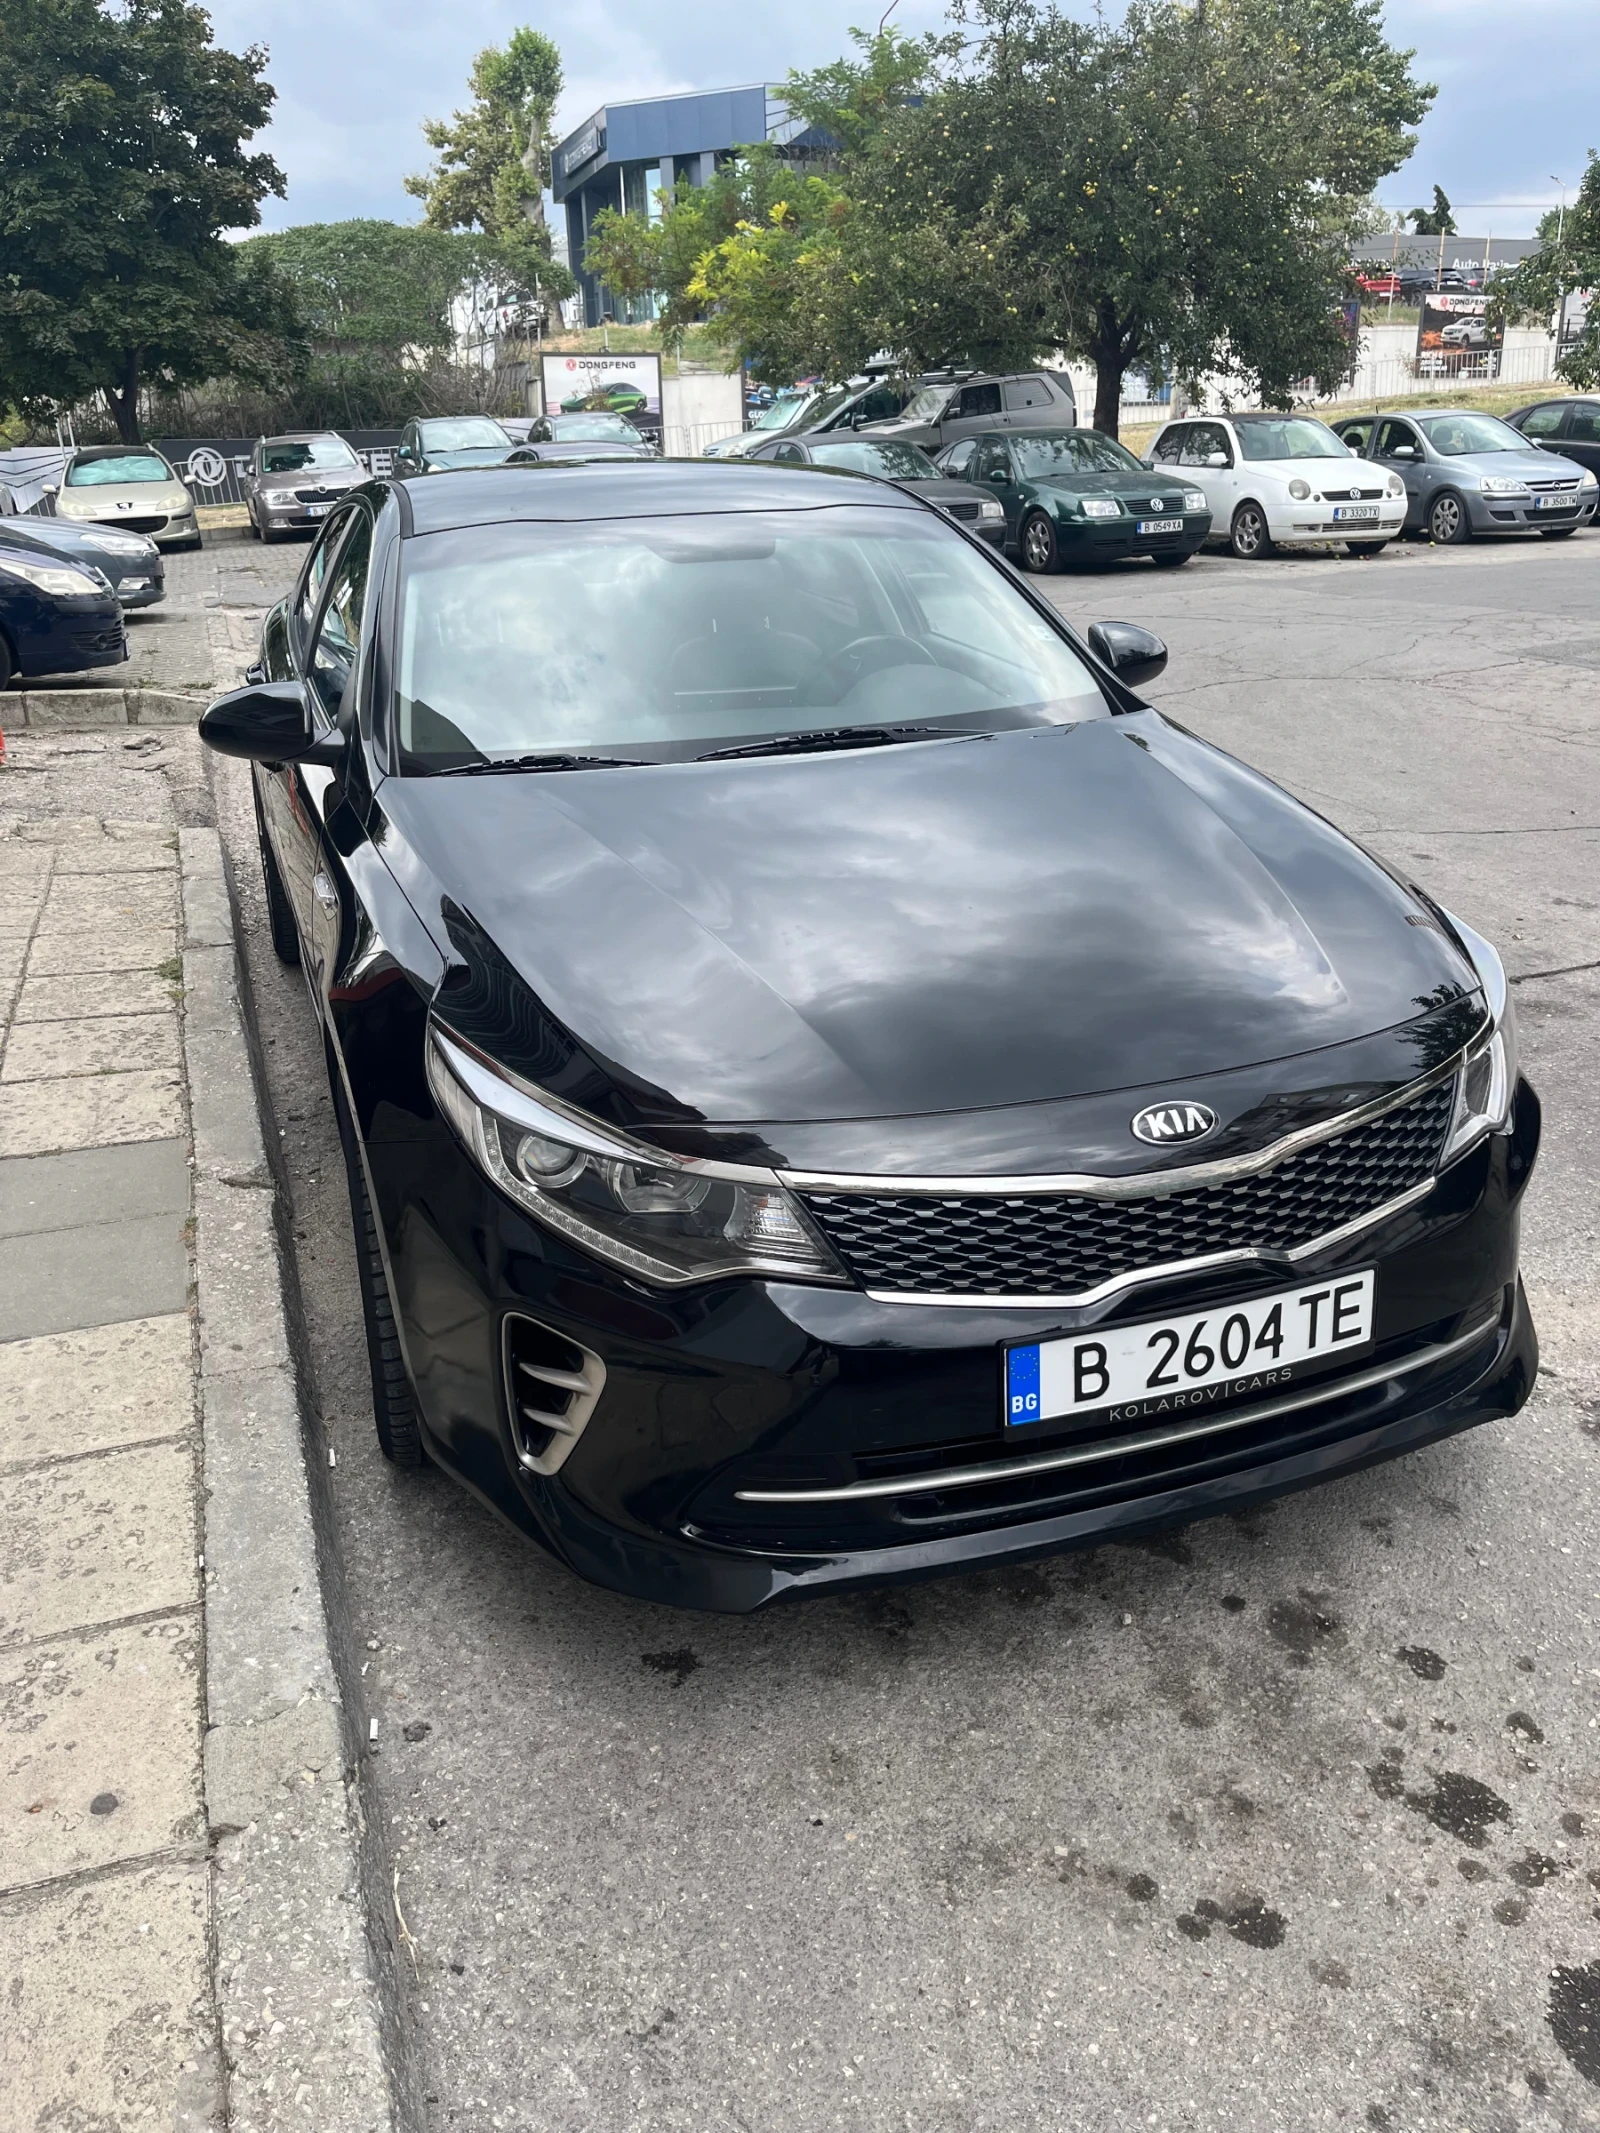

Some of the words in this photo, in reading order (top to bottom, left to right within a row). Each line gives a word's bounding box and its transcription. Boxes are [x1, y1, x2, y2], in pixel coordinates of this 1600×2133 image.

[1452, 258, 1479, 269] Auto
[1449, 298, 1489, 306] DONGFENG
[579, 361, 636, 369] DONGFENG
[748, 410, 770, 419] GLO
[1341, 509, 1347, 518] B
[1350, 508, 1367, 518] 3320
[1144, 522, 1150, 532] B
[1144, 1107, 1208, 1138] KIA
[1073, 1341, 1110, 1403] B
[1146, 1302, 1284, 1389] 2604
[1299, 1280, 1364, 1349] TE
[1011, 1392, 1038, 1414] BG
